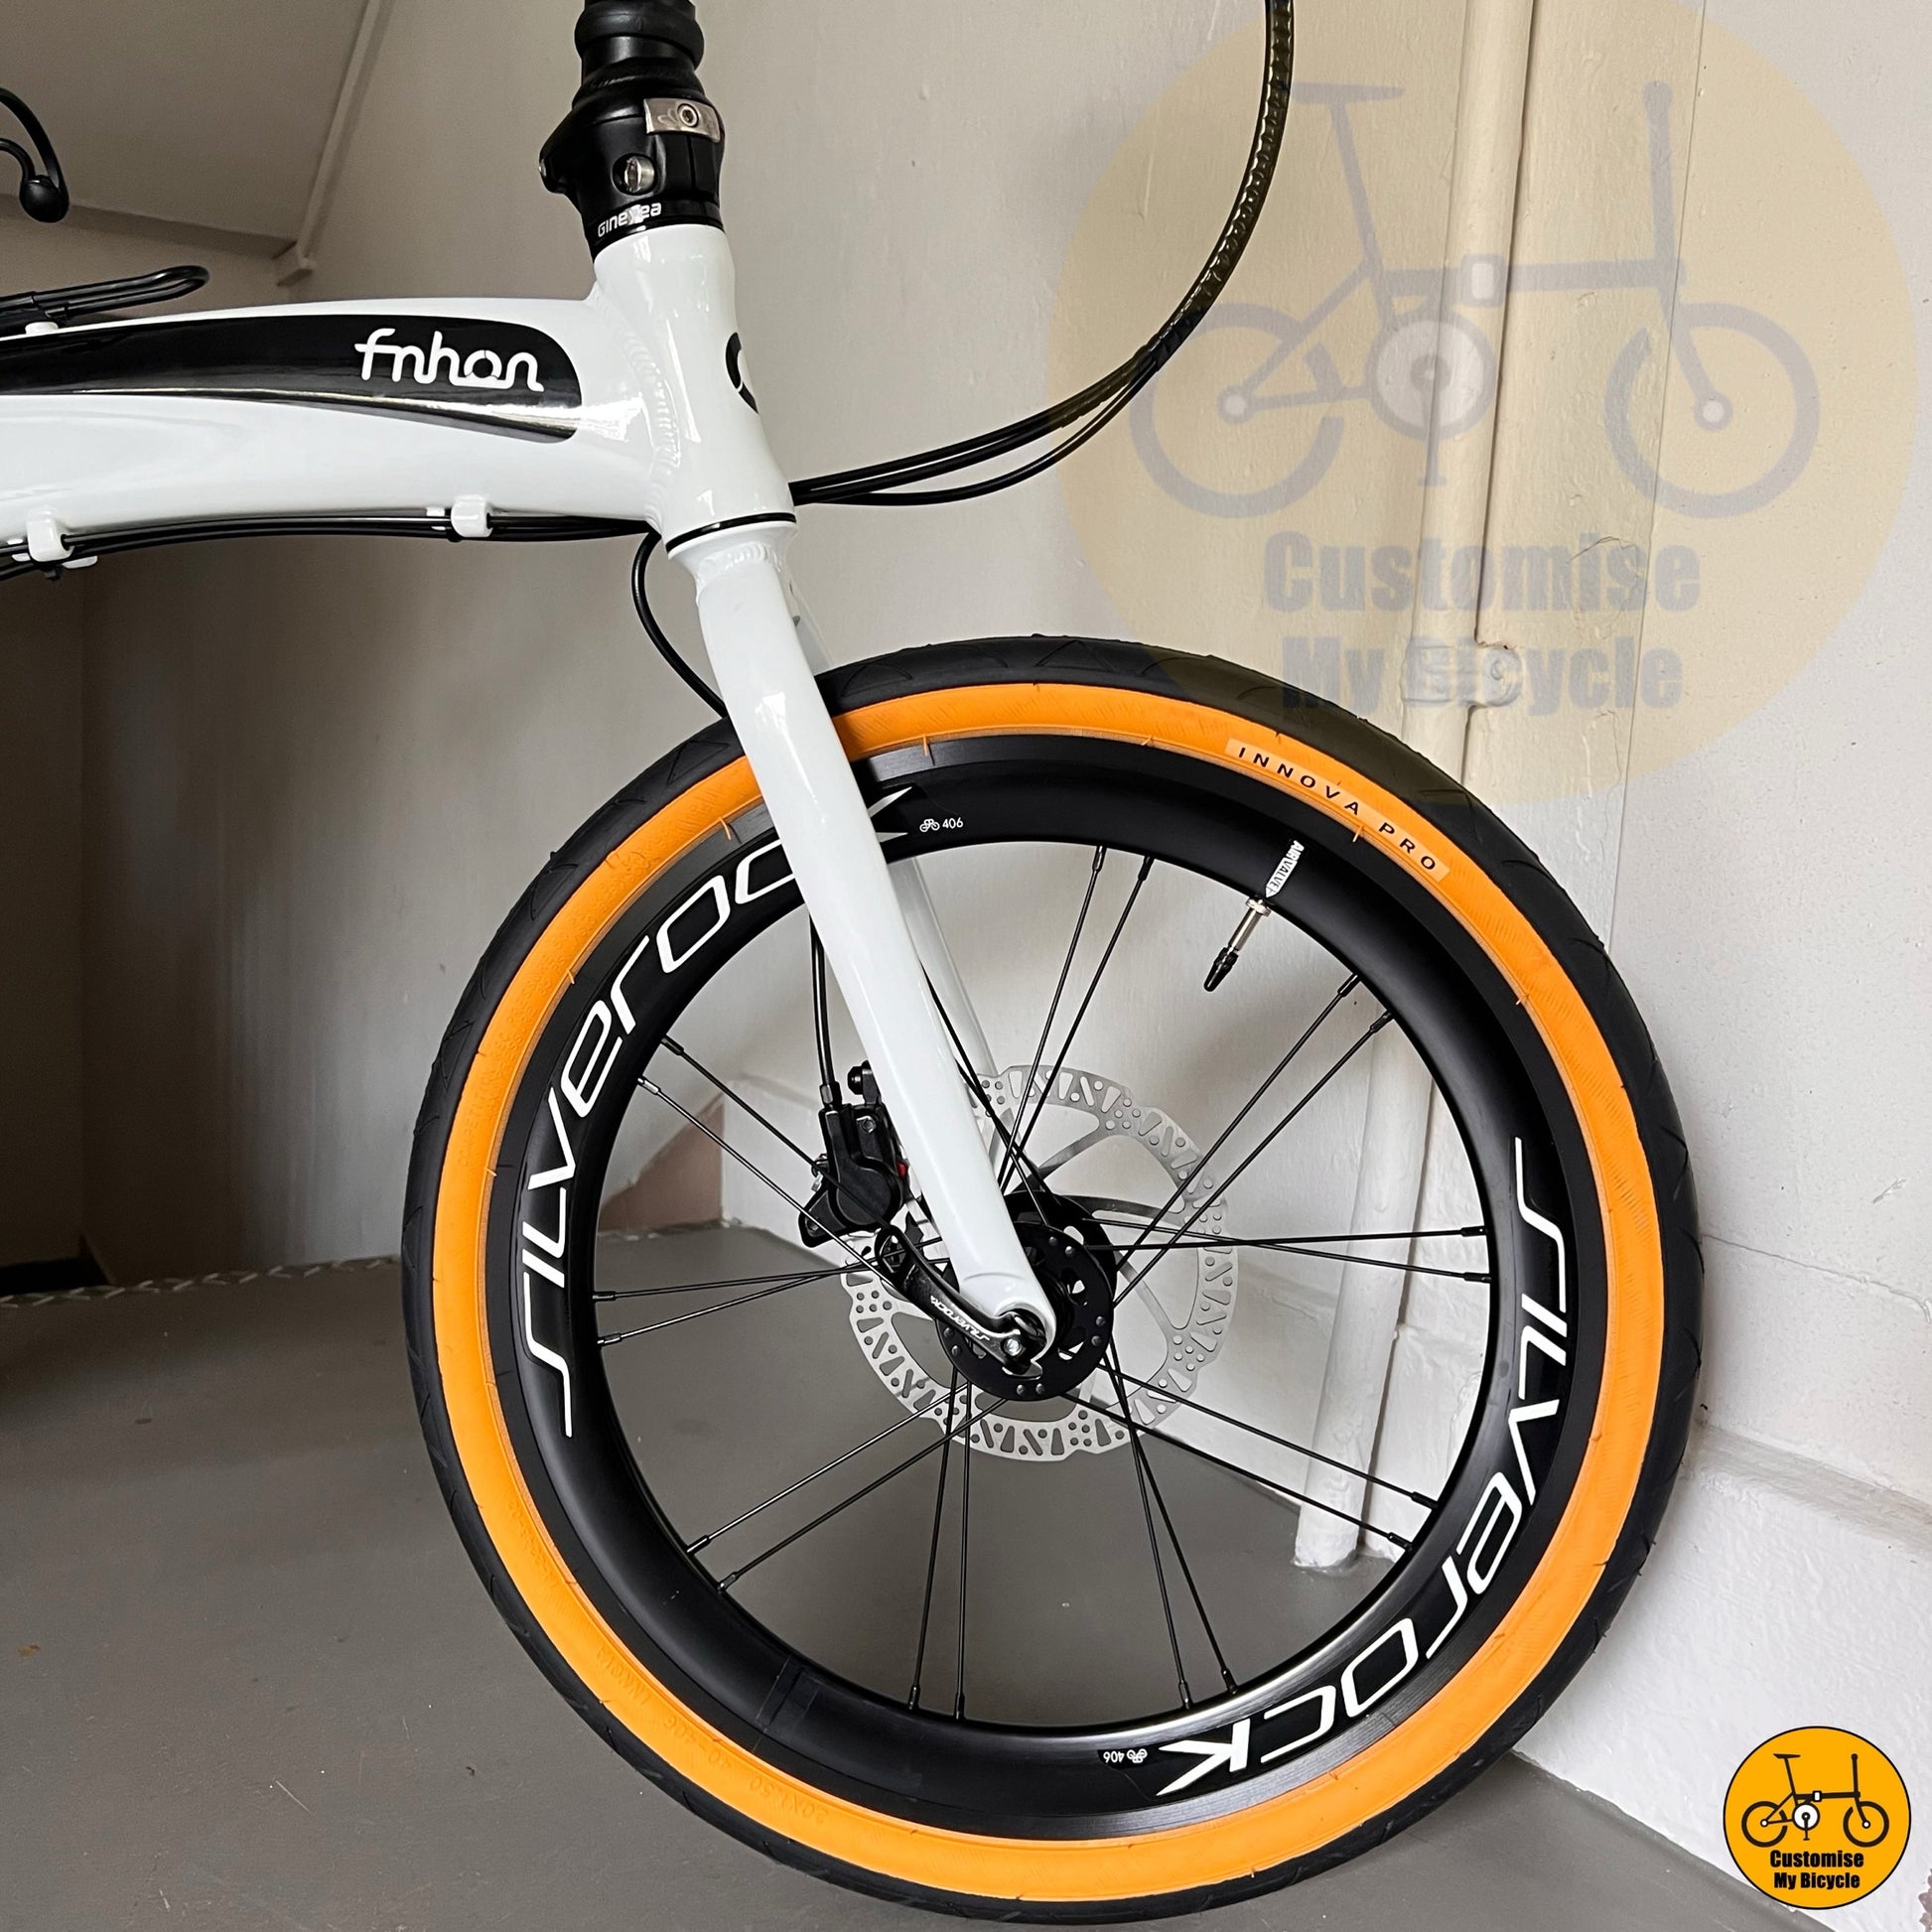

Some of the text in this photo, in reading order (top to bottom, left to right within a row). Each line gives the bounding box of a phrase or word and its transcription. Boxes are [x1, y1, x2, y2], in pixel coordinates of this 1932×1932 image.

[354, 328, 544, 392] fnhon
[942, 817, 964, 830] 406
[1238, 747, 1436, 872] INNOVA PRO
[1103, 1749, 1124, 1764] 406
